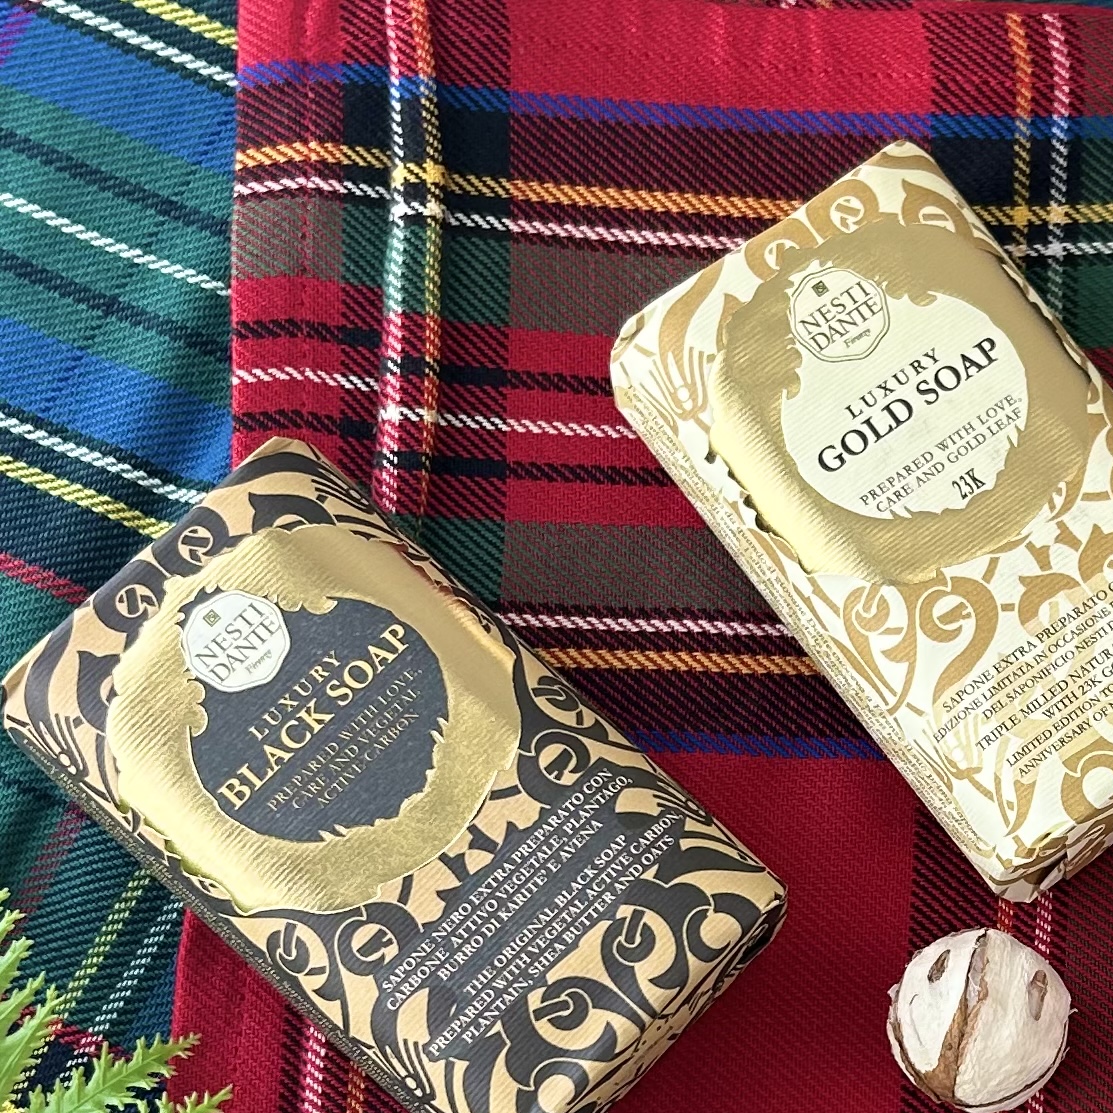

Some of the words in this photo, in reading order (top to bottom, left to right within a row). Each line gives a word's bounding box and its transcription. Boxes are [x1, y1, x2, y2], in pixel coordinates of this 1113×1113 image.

[798, 278, 871, 337] NESTI
[809, 293, 885, 353] DANTE
[813, 393, 917, 477] GOLD
[913, 334, 1004, 407] SOAP
[844, 346, 942, 420] LUXURY
[859, 449, 935, 506] PREPARED
[934, 420, 977, 454] WITH
[874, 481, 914, 514] CARE
[912, 459, 947, 488] AND
[945, 430, 988, 465] GOLD
[985, 406, 1024, 437] LEAF
[950, 465, 986, 501] 23K
[193, 599, 266, 670] NESTI
[208, 612, 283, 685] DANTE
[932, 696, 984, 744] EDIZIONE
[981, 658, 1036, 702] LIMITATA
[1032, 648, 1048, 665] IN
[1046, 605, 1112, 655] OCCASIONE
[941, 668, 994, 714] SAPONE
[992, 637, 1037, 674] EXTRA
[1035, 588, 1109, 644] PREPARATO
[981, 695, 1010, 720] DEL
[1005, 647, 1077, 703] SAPONIFICIO
[1073, 625, 1109, 654] NESTI
[216, 694, 336, 813] BLACK
[323, 619, 414, 710] SOAP
[248, 648, 343, 742] LUXURY
[974, 712, 1022, 754] TRIPLE
[1018, 677, 1070, 719] MILLED
[1005, 727, 1054, 768] LIMITED
[1051, 693, 1102, 733] EDITION
[1016, 717, 1093, 778] ANNIVERSARY
[1090, 703, 1111, 723] OF
[1040, 689, 1079, 722] WITH
[1076, 672, 1103, 696] 23K
[266, 739, 341, 813] PREPARED
[337, 702, 379, 744] WITH
[290, 772, 329, 811] CARE
[327, 741, 361, 775] AND
[356, 683, 422, 747] VEGETAL
[316, 757, 368, 809] ACTIVE
[362, 707, 420, 763] CARBON
[380, 937, 436, 994] SAPONE
[430, 900, 474, 943] NERO
[469, 858, 515, 906] EXTRA
[510, 789, 586, 864] PREPARATO
[581, 765, 613, 796] CON
[385, 945, 451, 1012] CARBONE
[448, 896, 500, 949] ATTIVO
[494, 829, 568, 902] VEGETALE,
[562, 770, 634, 836] PLANTAGO,
[436, 932, 485, 982] BURRO
[480, 916, 501, 939] DI
[546, 856, 562, 873] E
[556, 815, 604, 863] AVENA
[462, 963, 497, 999] THE
[492, 902, 559, 970] ORIGINAL
[553, 862, 599, 909] BLACK
[593, 832, 629, 869] SOAP
[428, 986, 497, 1058] PREPARED
[491, 950, 532, 993] WITH
[526, 894, 589, 957] VEGETAL
[583, 850, 634, 901] ACTIVE
[629, 806, 684, 857] CARBON,
[461, 972, 535, 1045] PLANTAIN,
[527, 938, 566, 979] SHEA
[561, 889, 617, 945] BUTTER
[612, 861, 645, 895] AND
[639, 832, 676, 867] OATS
